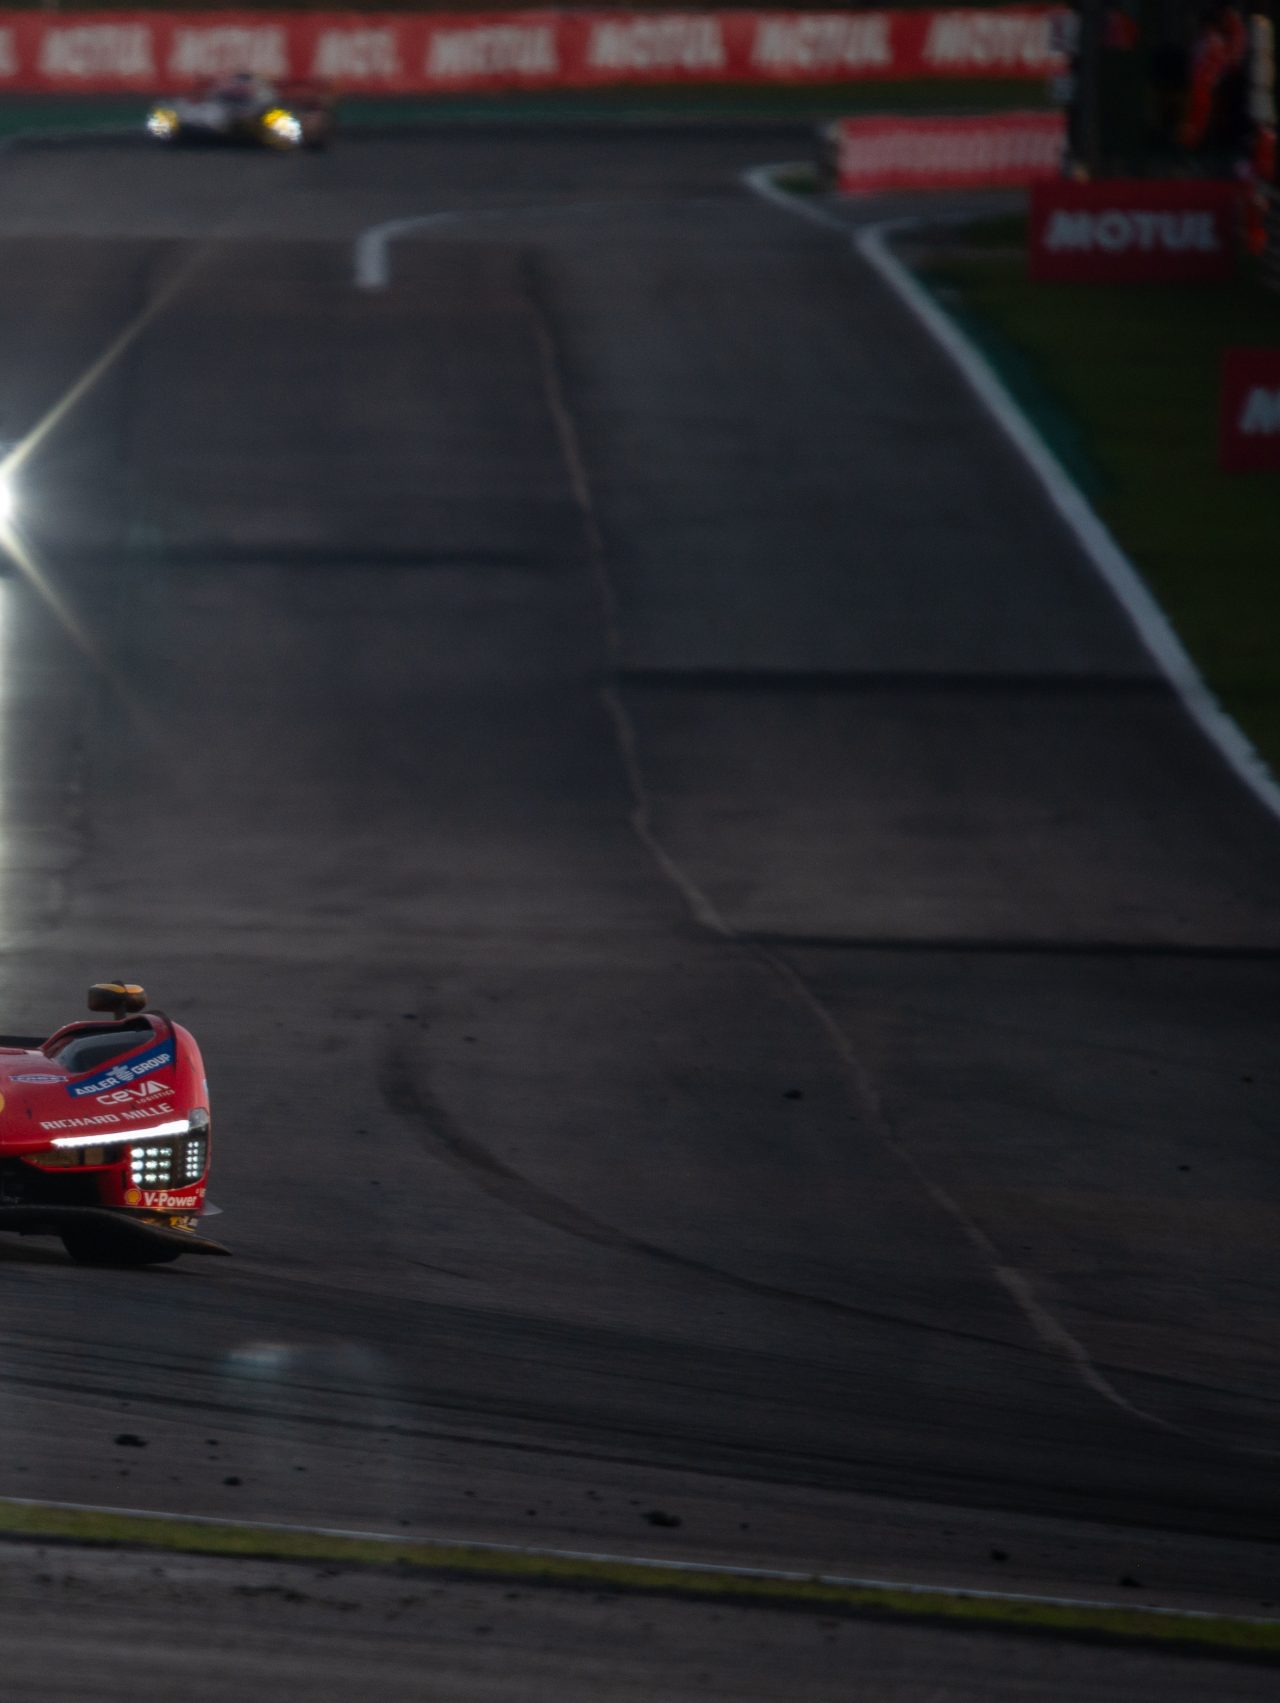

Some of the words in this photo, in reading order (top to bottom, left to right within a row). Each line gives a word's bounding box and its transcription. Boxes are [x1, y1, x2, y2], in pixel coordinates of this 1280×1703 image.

[1044, 210, 1217, 250] MOTUL
[74, 1078, 121, 1096] ADLER
[131, 1053, 171, 1075] GROUP
[39, 1113, 121, 1130] RICHARD
[121, 1103, 174, 1120] MILLE
[144, 1192, 197, 1207] V-Power
